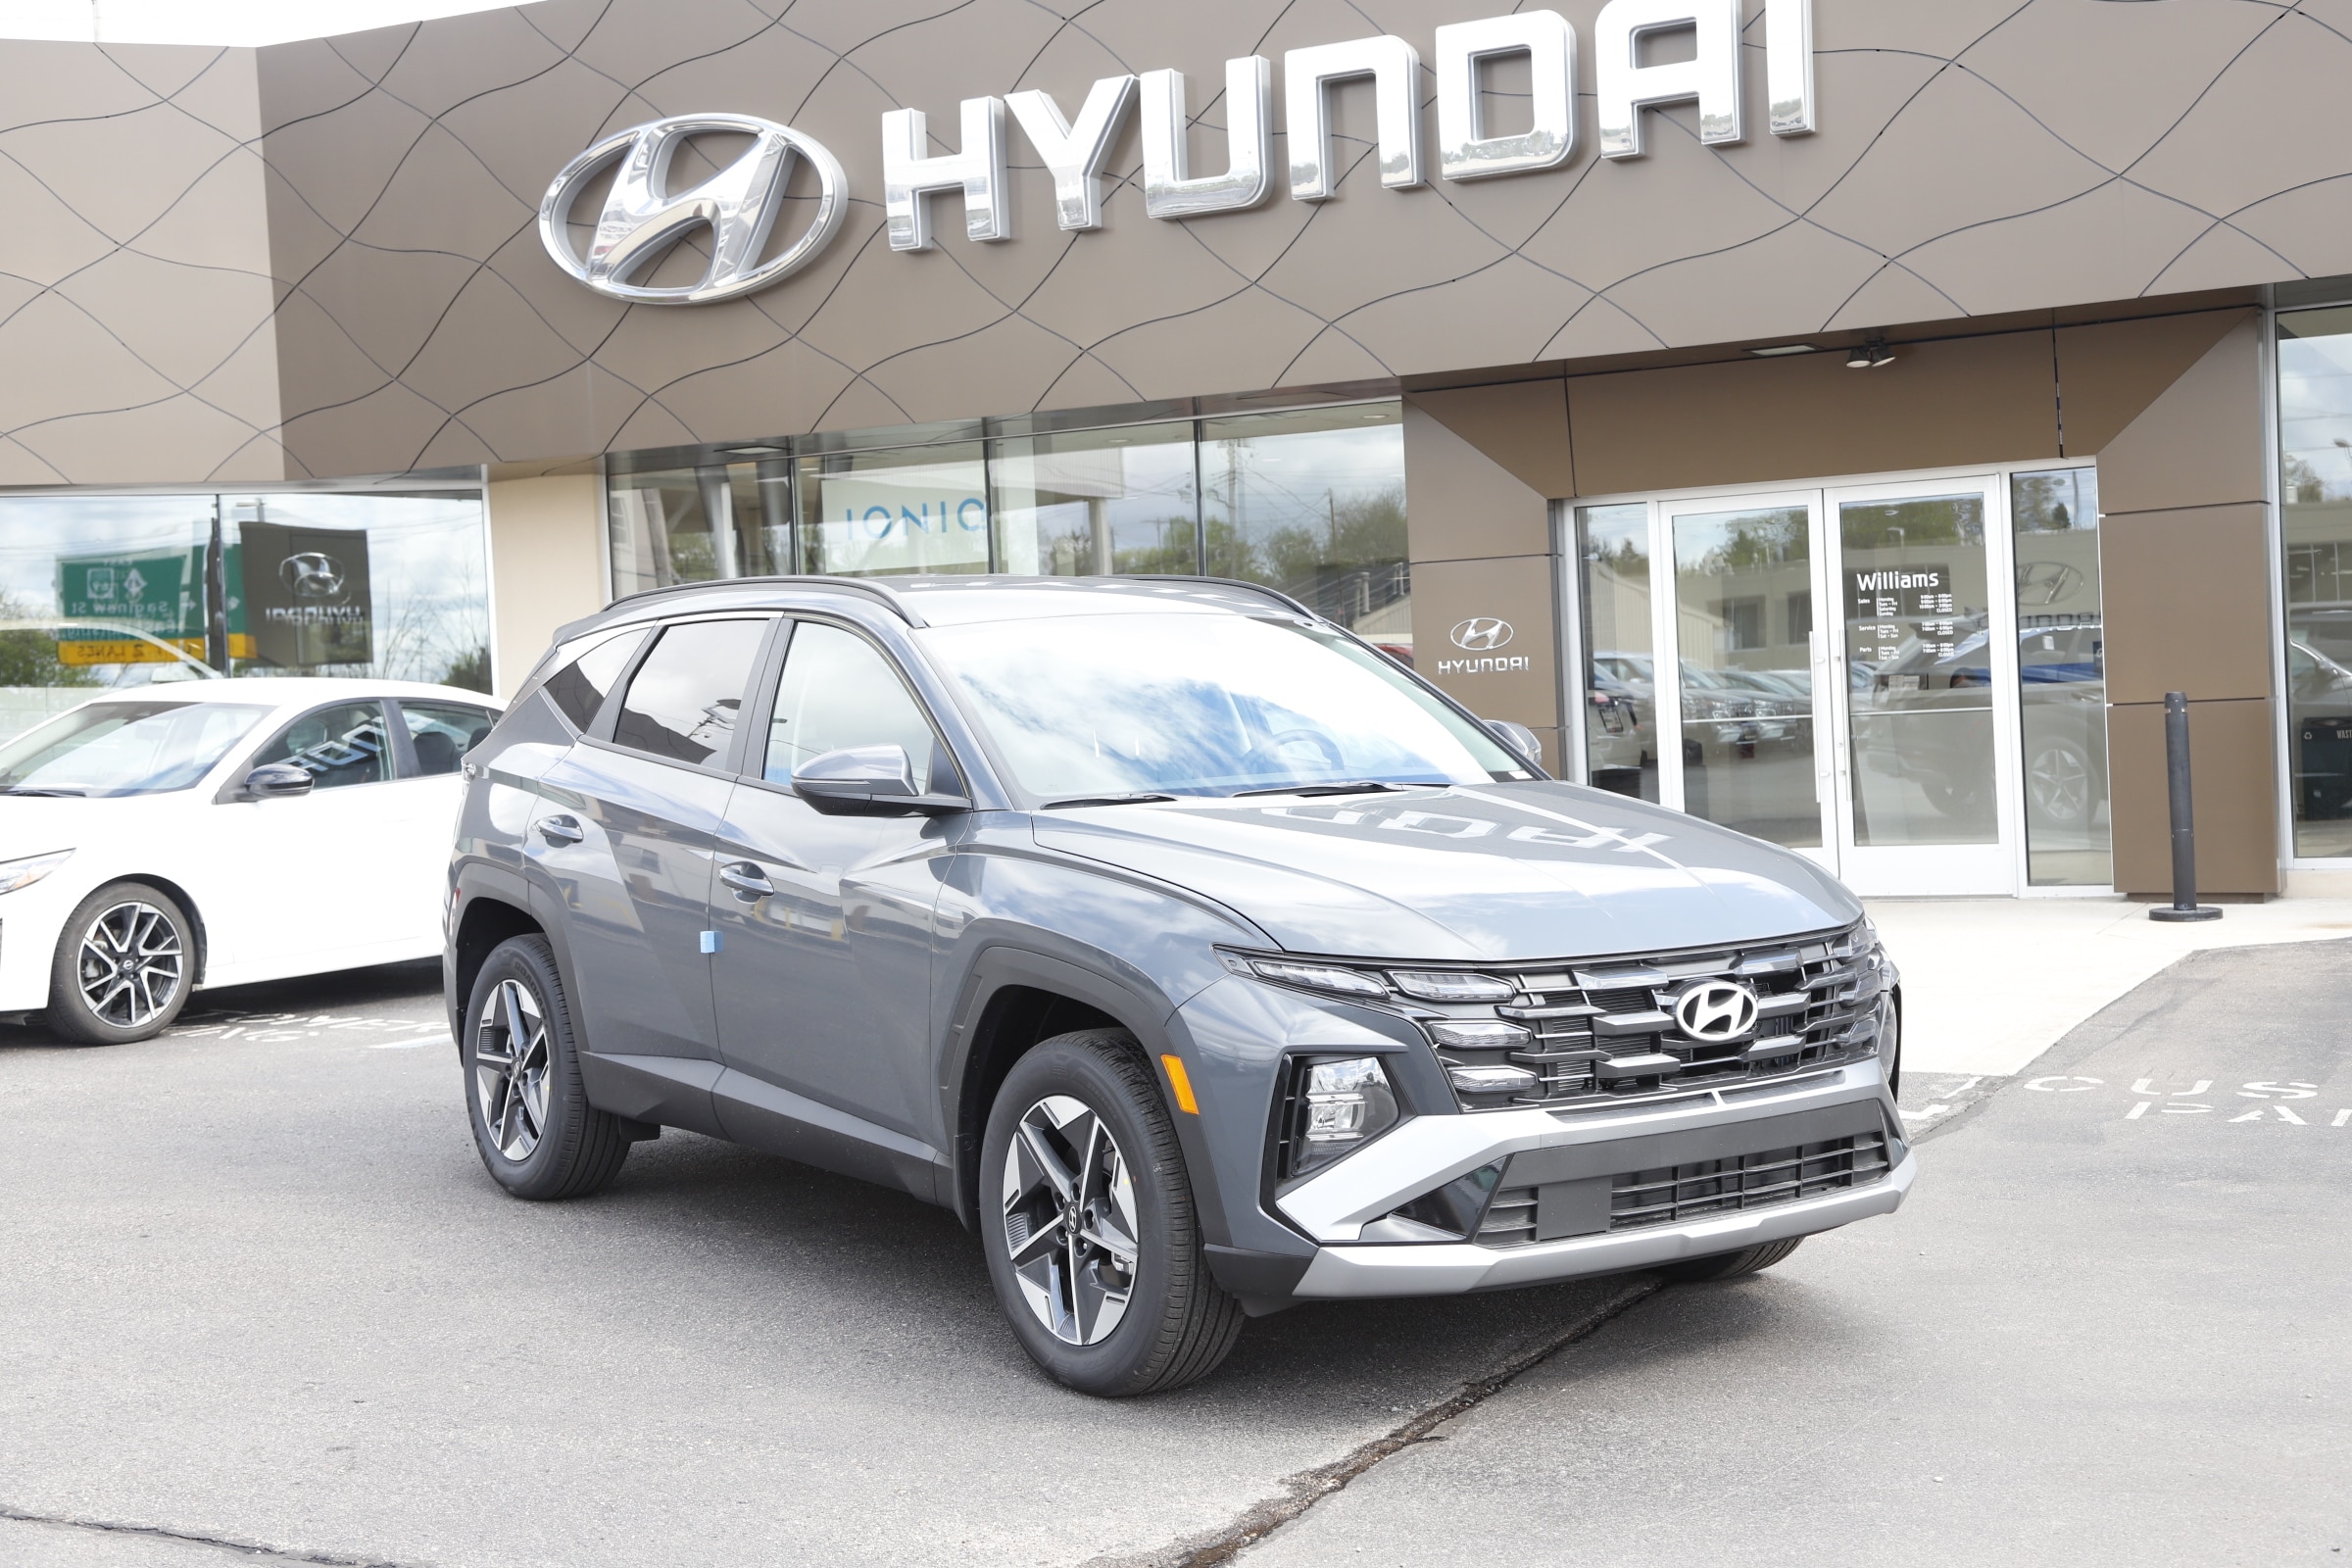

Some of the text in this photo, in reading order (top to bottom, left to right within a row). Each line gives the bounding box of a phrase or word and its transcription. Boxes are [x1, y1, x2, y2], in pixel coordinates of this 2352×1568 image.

[882, 0, 1816, 253] HYUNDAI
[1856, 570, 1939, 592] Williams
[1438, 656, 1529, 675] HYUNDAI
